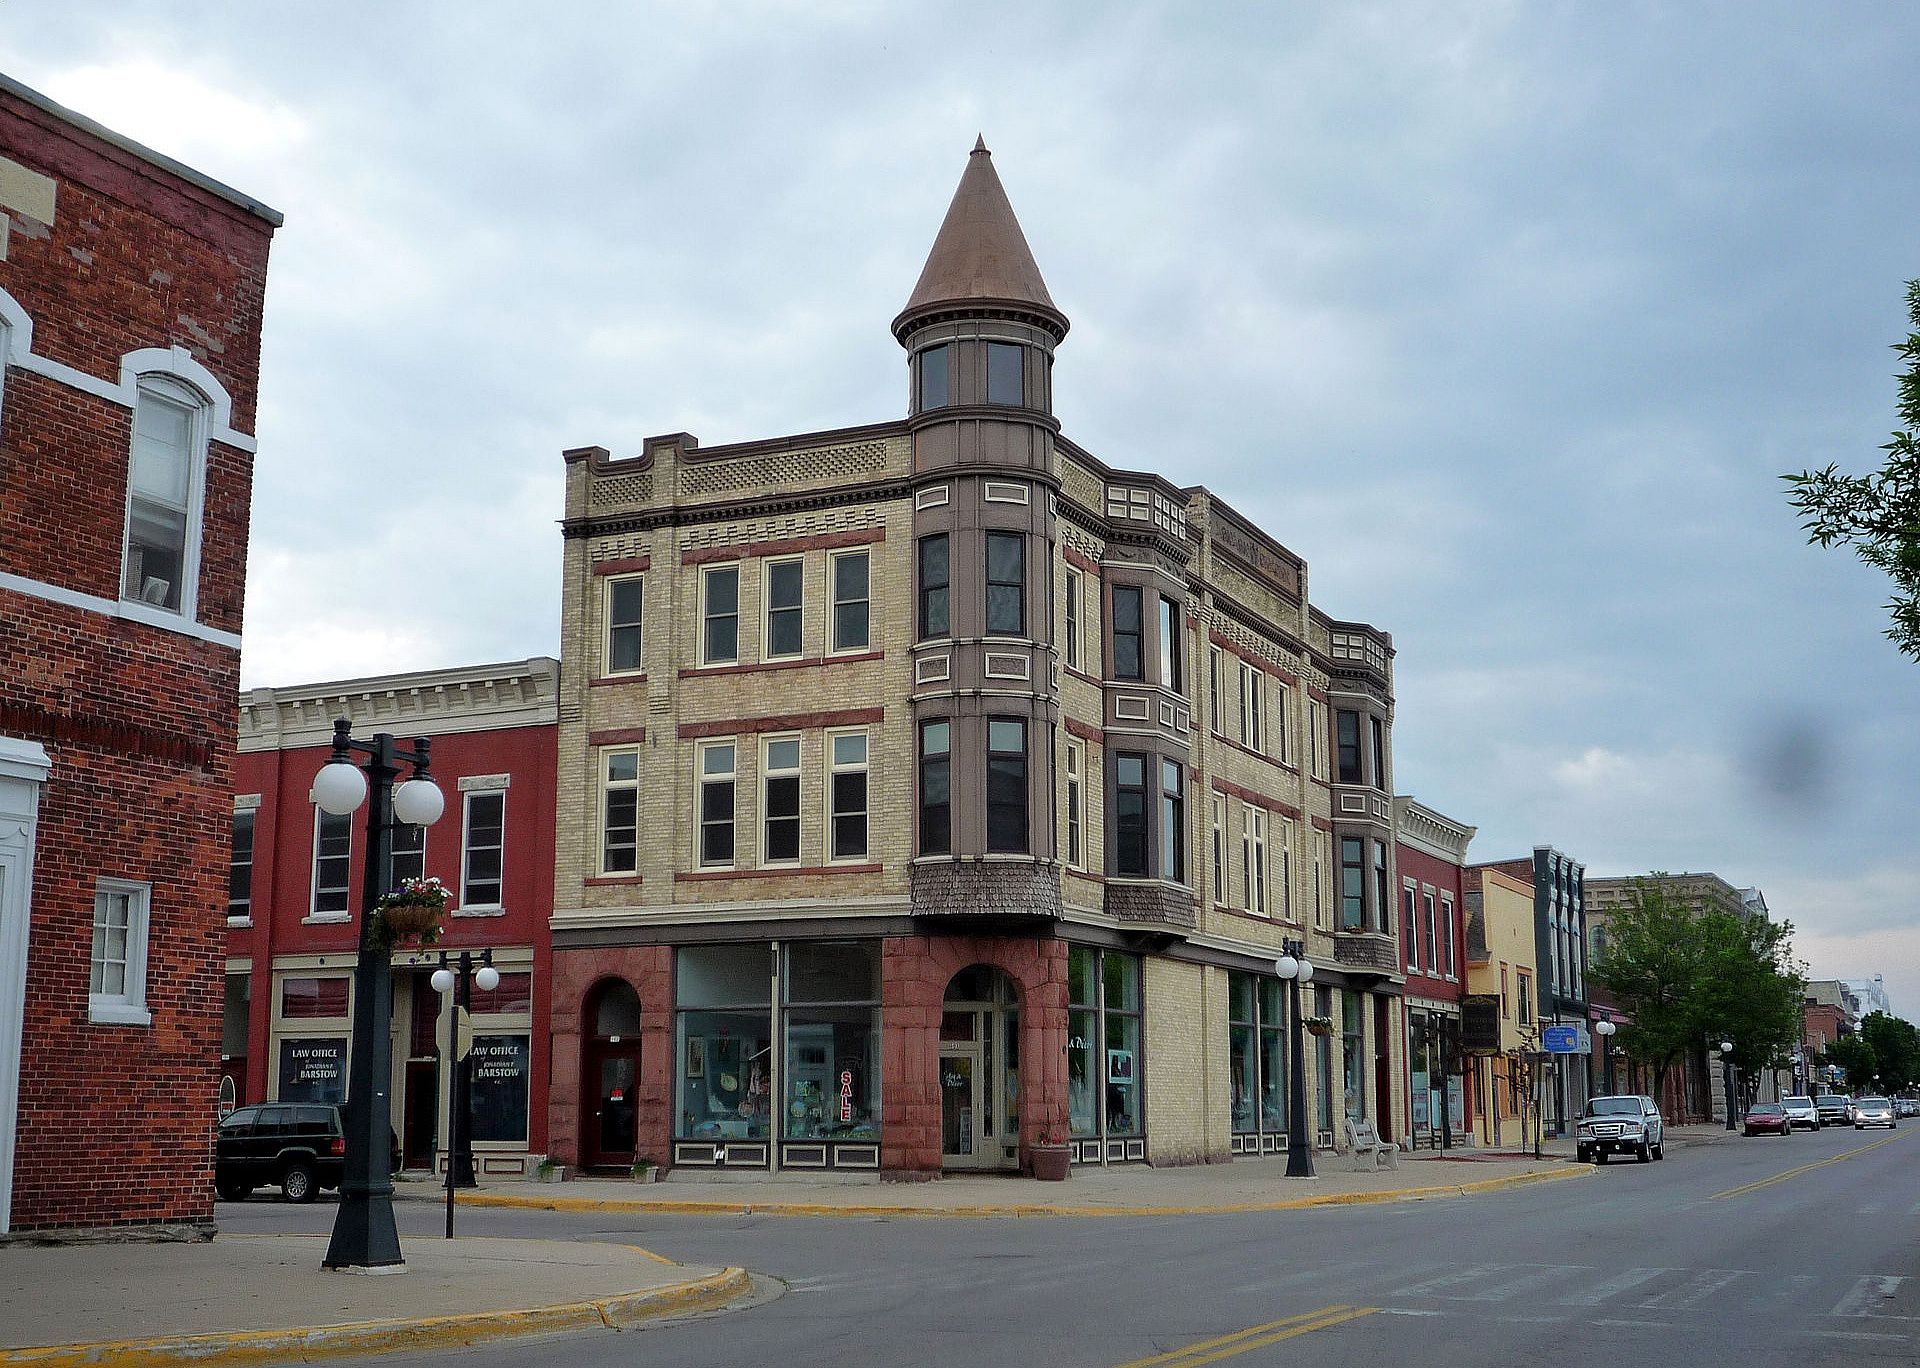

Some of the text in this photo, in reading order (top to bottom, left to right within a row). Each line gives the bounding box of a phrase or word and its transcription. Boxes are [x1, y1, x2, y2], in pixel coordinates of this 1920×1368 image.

[292, 1048, 337, 1058] LAW OFFICE
[469, 1046, 519, 1056] LAW OFFICE
[300, 1070, 337, 1079] BARSTOW
[478, 1068, 519, 1077] BARSTOW
[840, 1070, 852, 1122] SALE
